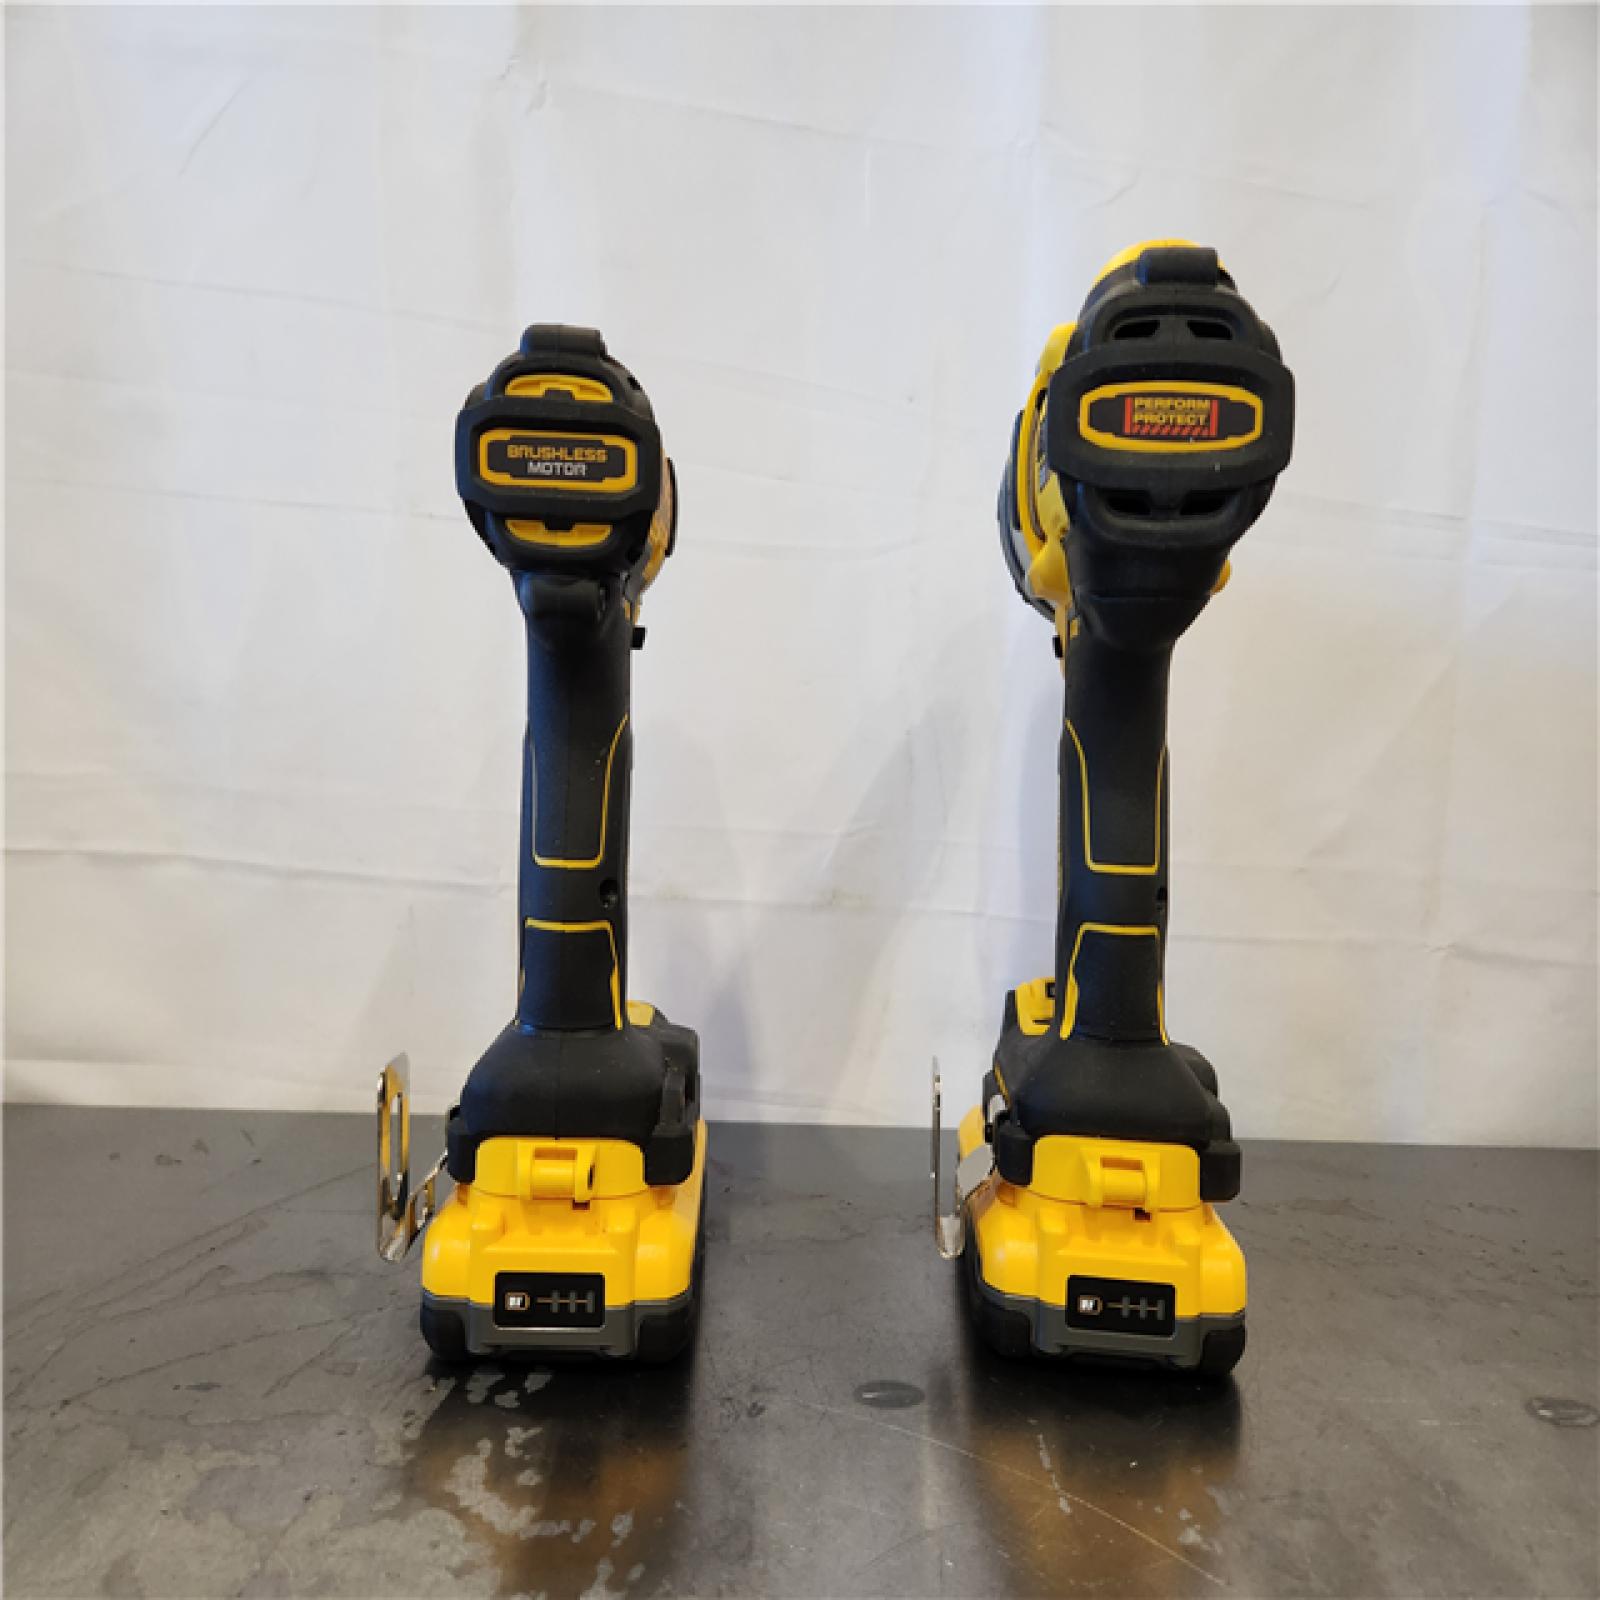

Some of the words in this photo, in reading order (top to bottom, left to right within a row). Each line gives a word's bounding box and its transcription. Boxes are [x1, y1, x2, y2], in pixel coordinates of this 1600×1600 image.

[1134, 397, 1212, 410] PERFORM
[1134, 413, 1208, 426] PROTECT
[506, 444, 608, 463] BRUSHLESS
[527, 461, 587, 476] MOTOR
